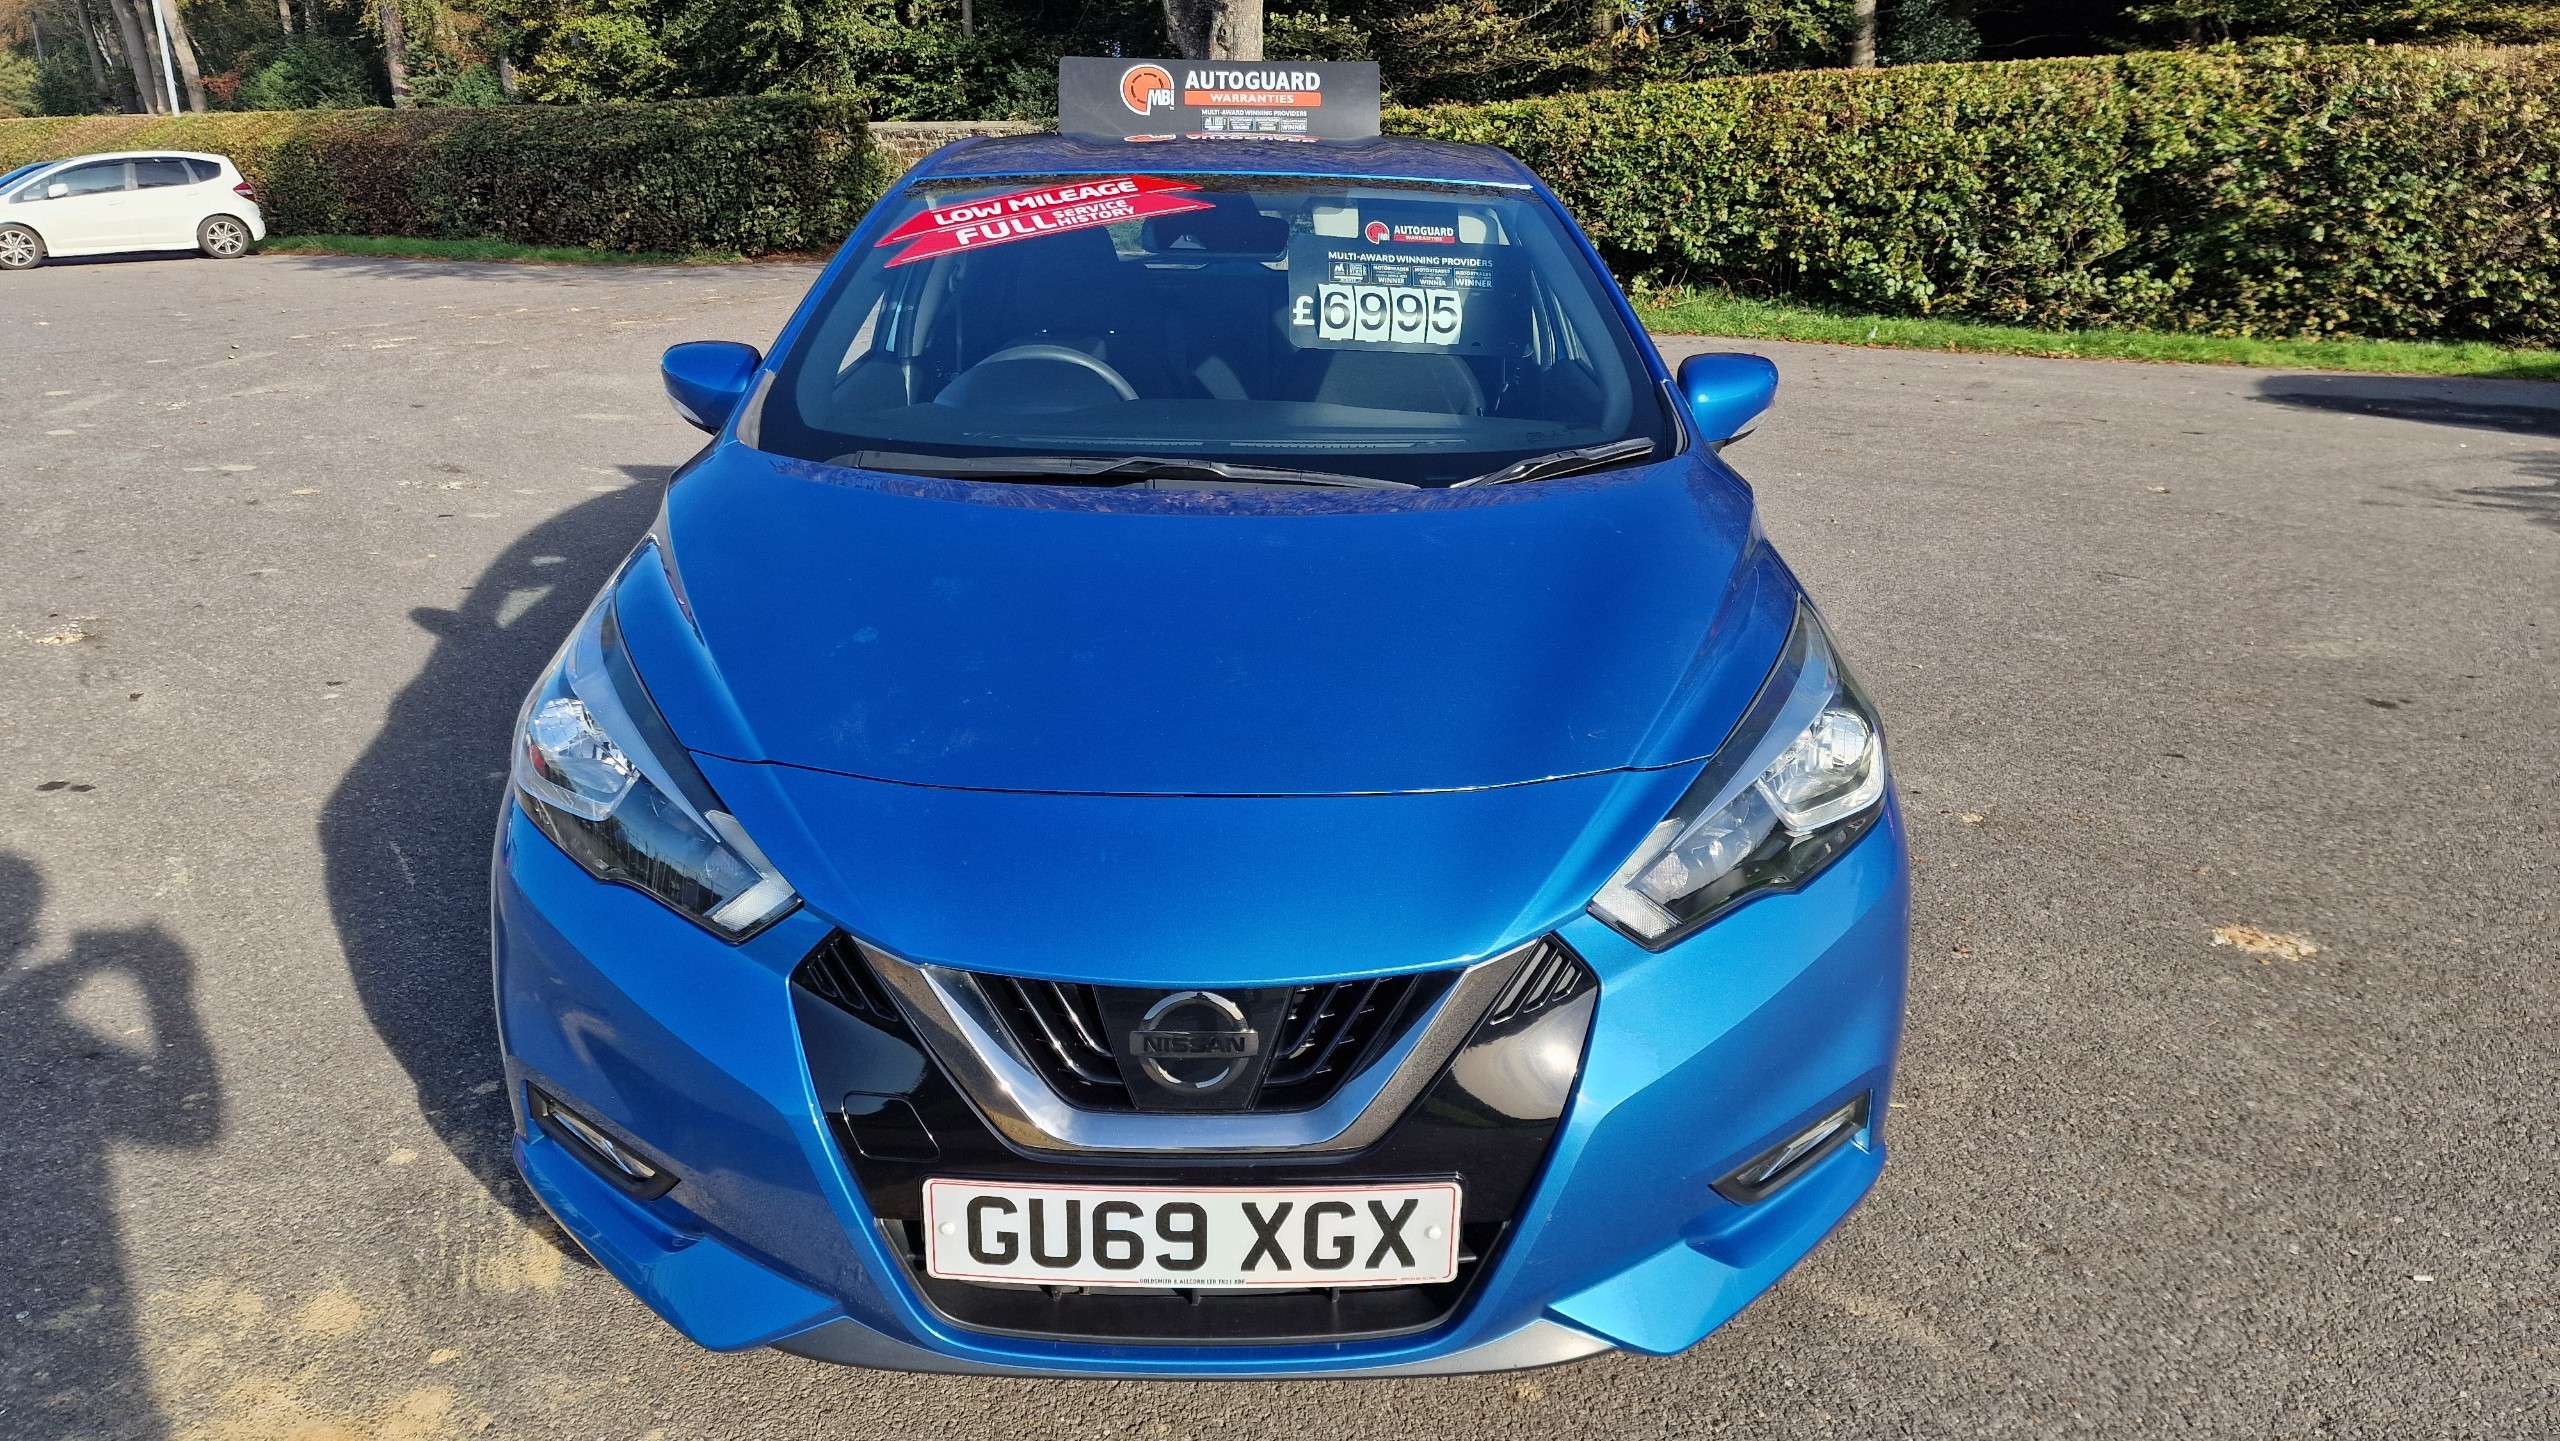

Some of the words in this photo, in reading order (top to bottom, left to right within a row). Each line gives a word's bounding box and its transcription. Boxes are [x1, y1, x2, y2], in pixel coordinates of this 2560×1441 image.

[1184, 71, 1321, 91] AUTOGUARD
[1210, 93, 1295, 104] WARRANTIES
[933, 201, 1003, 226] LOW
[1008, 180, 1139, 213] MILEAGE
[1053, 199, 1128, 220] SERVICE
[1057, 205, 1135, 227] HISTORY
[955, 215, 1057, 247] FULL
[1394, 225, 1455, 237] AUTOGUARD
[1328, 251, 1396, 263] MULTI-AWARD
[1396, 255, 1440, 266] WINNING
[1441, 257, 1494, 268] PROVIDERS
[1455, 278, 1493, 287] WINNER
[1143, 1036, 1246, 1053] NISSAN
[966, 1195, 1208, 1271] GU69
[1240, 1198, 1420, 1272] XGX
